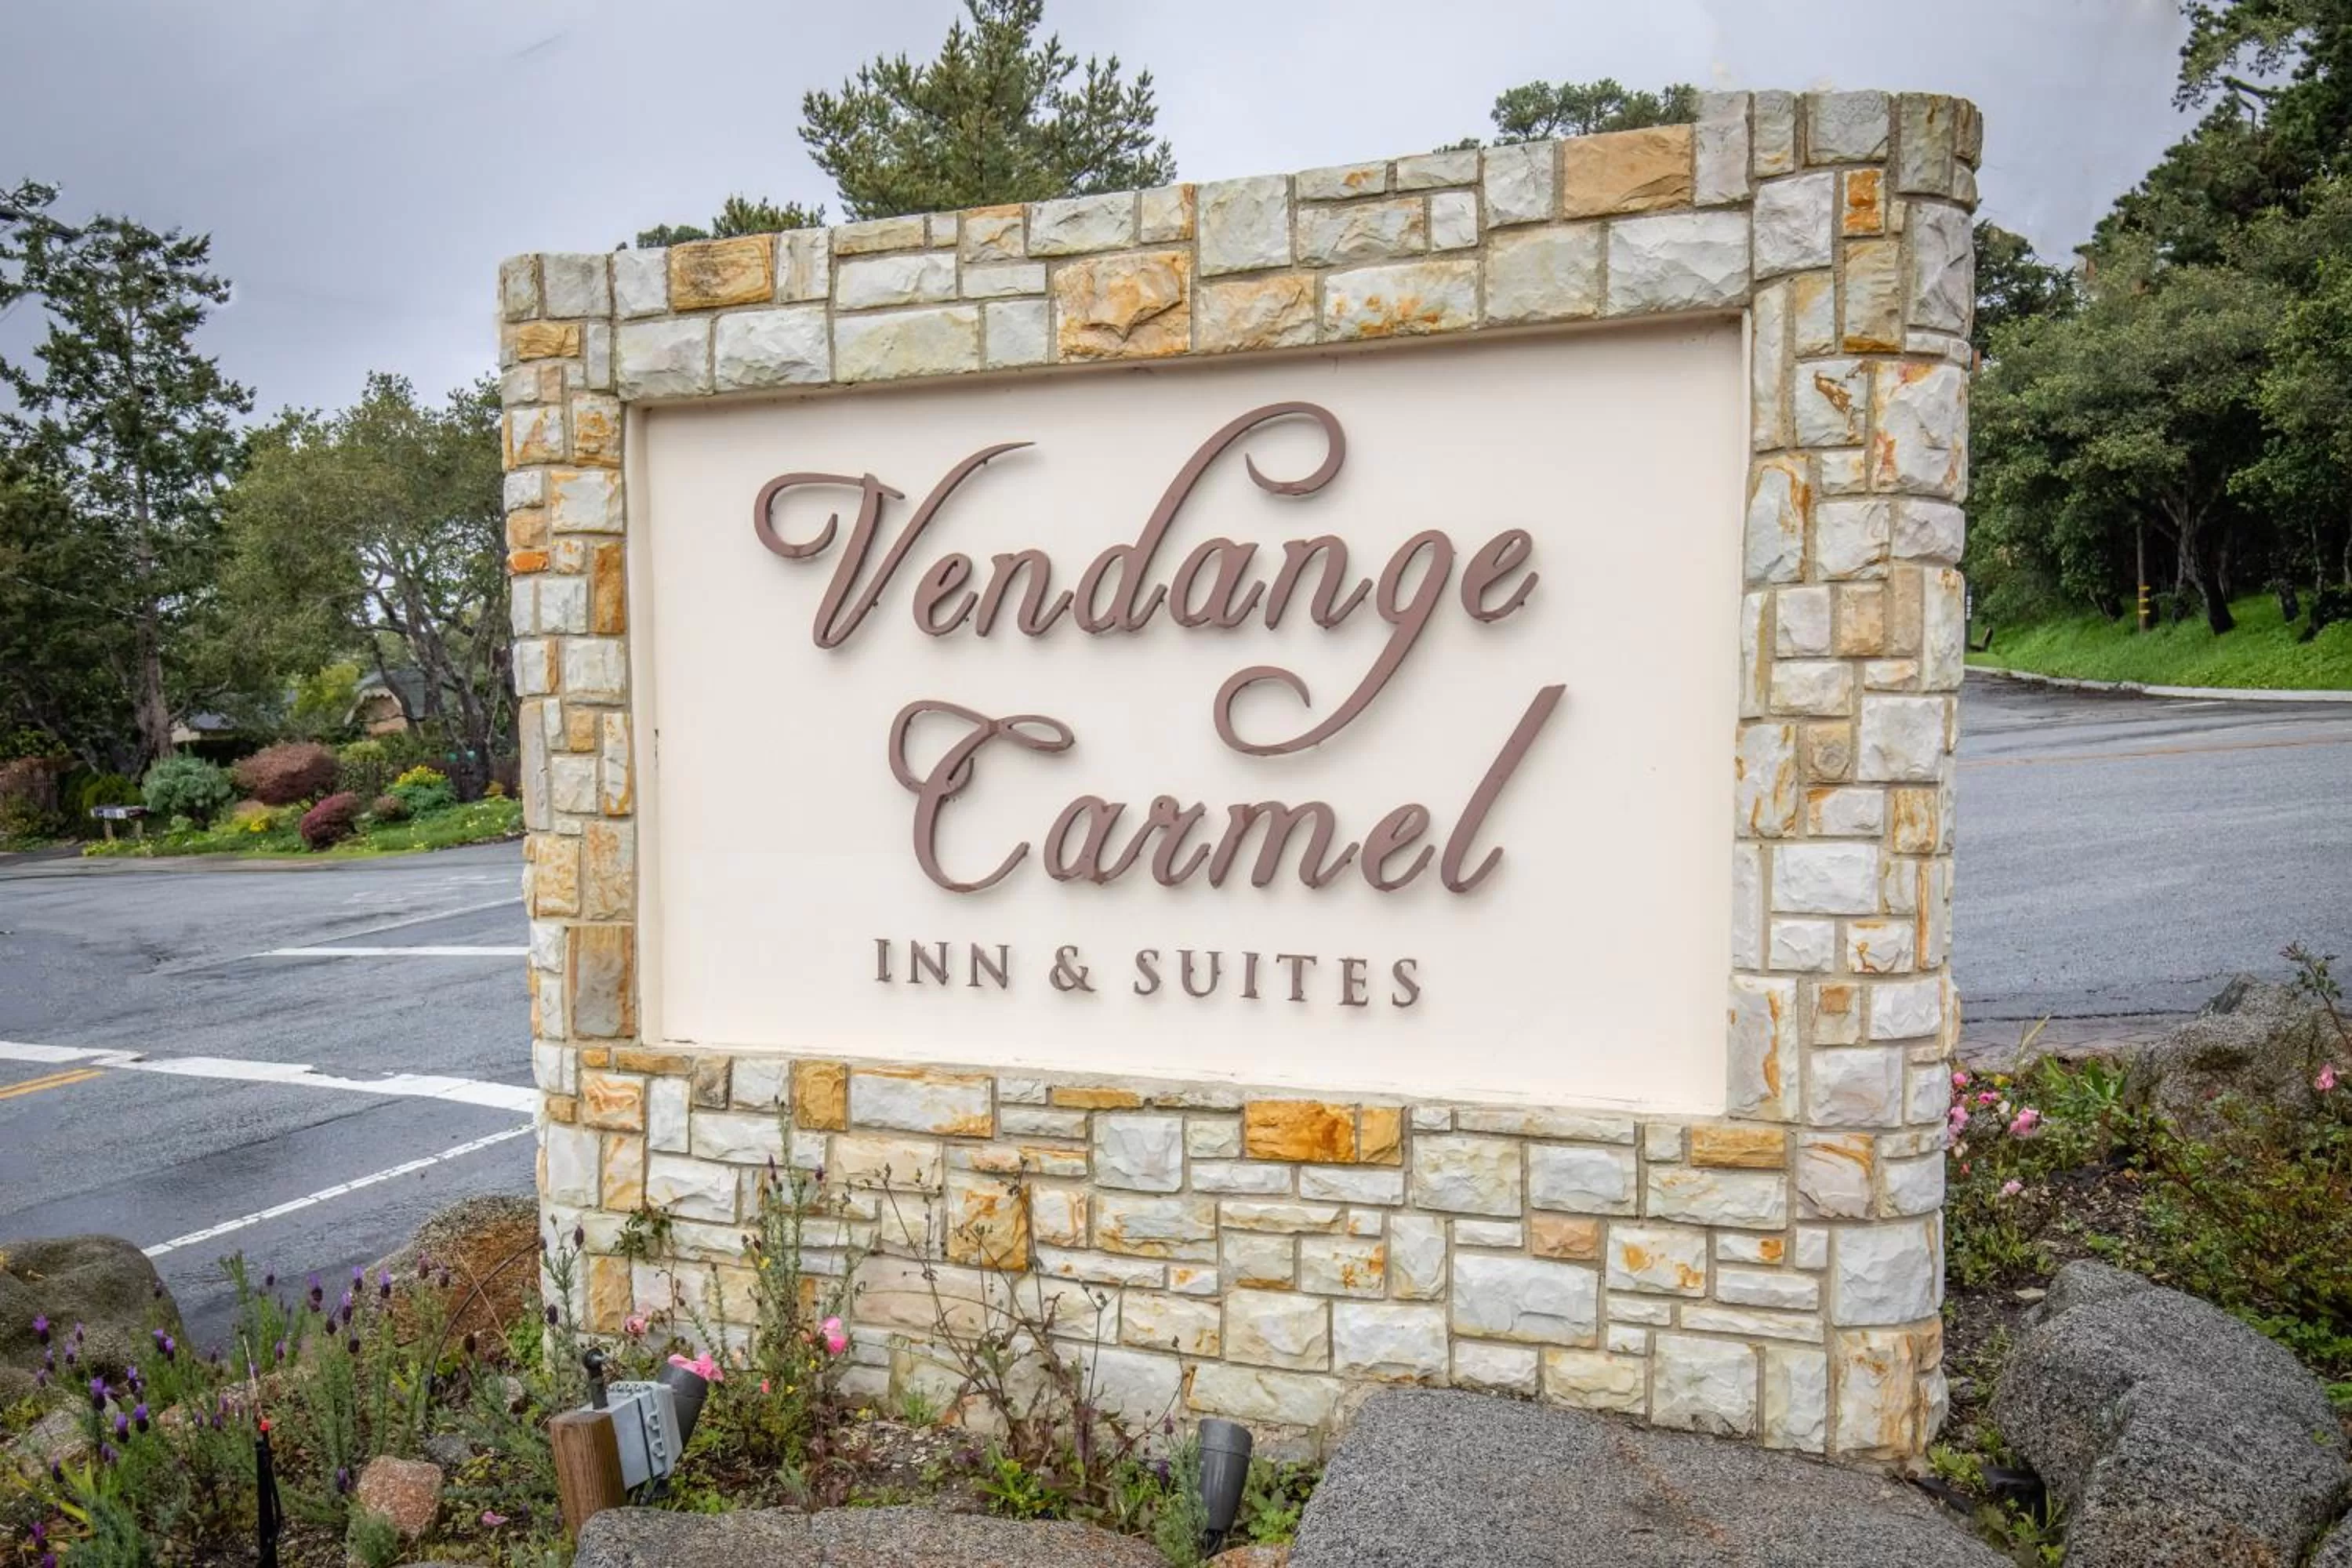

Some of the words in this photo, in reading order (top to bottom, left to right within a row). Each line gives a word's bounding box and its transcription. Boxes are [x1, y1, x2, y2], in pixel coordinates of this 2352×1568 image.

[754, 401, 1540, 757] Vendange
[889, 684, 1566, 894] Carmel
[875, 938, 1010, 989] INN
[1049, 945, 1096, 993] &
[1134, 949, 1421, 1008] SUITES
